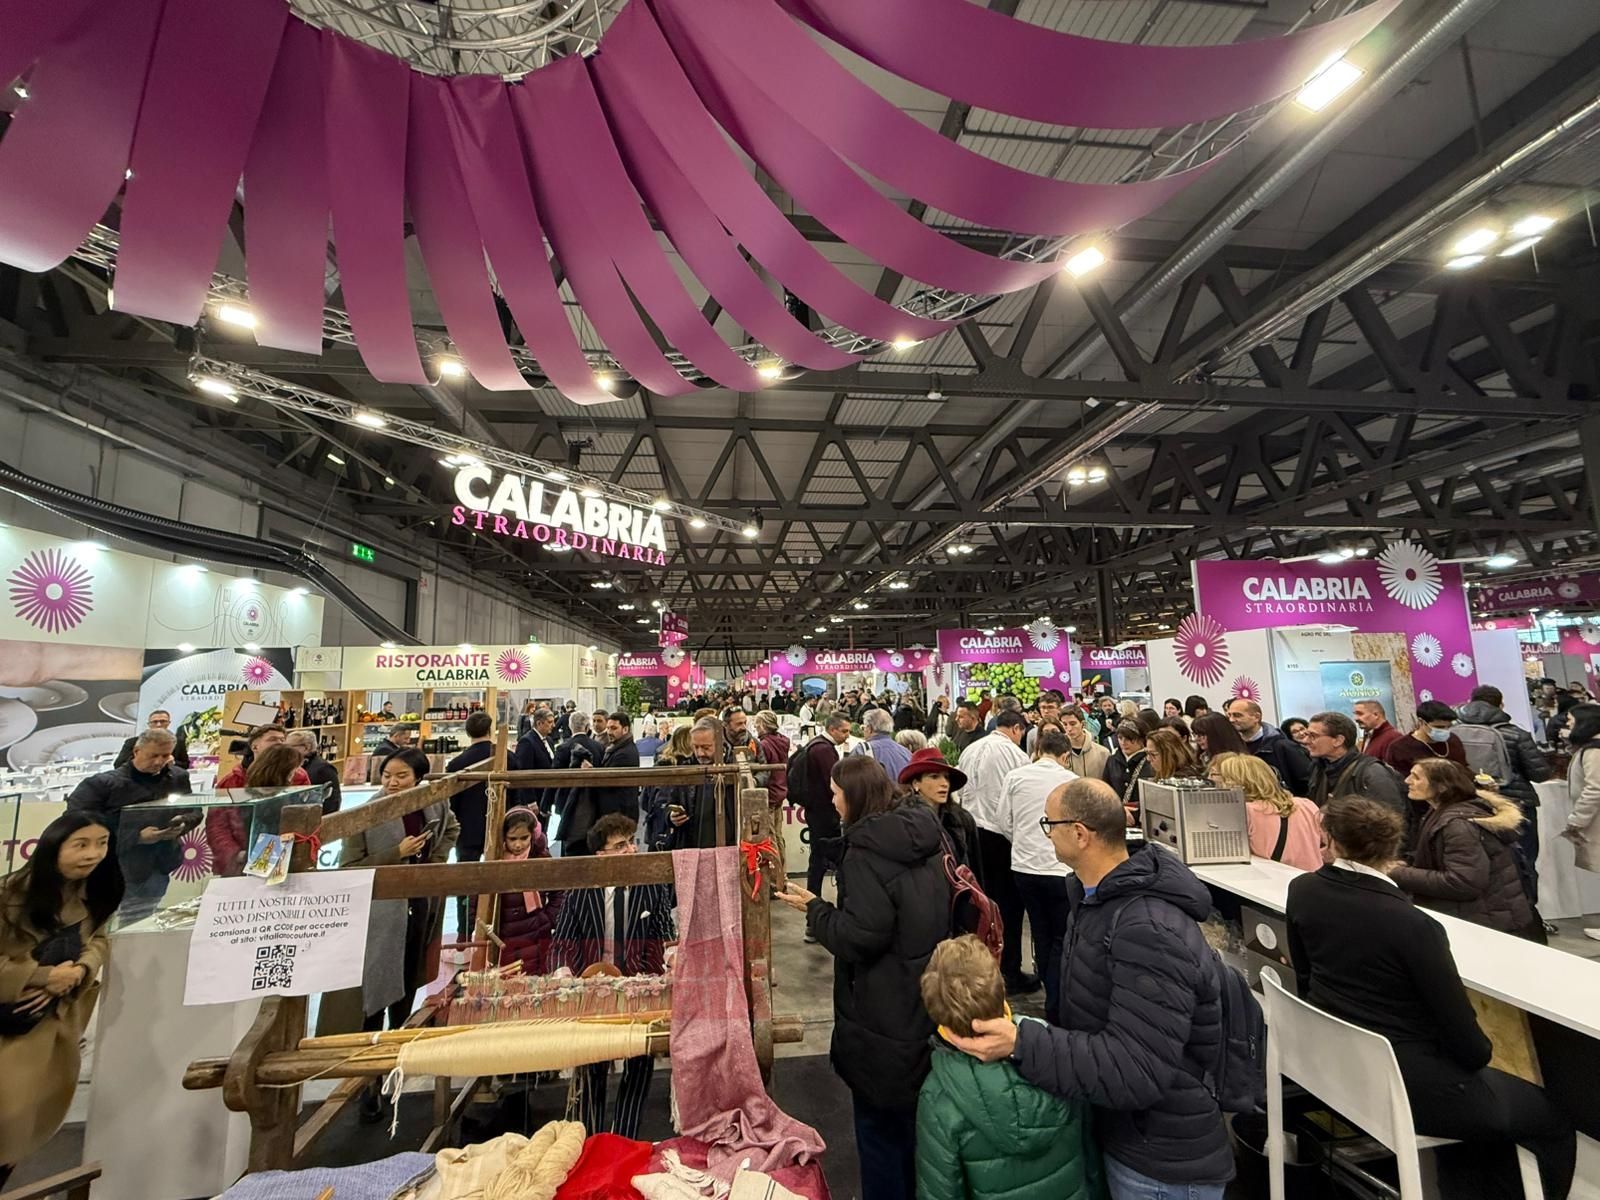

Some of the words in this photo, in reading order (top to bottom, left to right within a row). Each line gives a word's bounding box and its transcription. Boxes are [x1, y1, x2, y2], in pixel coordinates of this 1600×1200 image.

[453, 465, 667, 551] CALABRIA
[451, 506, 667, 567] STRAORDINARIA
[1242, 577, 1371, 601] CALABRIA
[1499, 587, 1553, 601] CALABRIA
[1245, 602, 1374, 613] STRAORDINARIA
[959, 636, 1022, 649] CALABRIA
[376, 653, 490, 668] RISTORANTE
[814, 653, 876, 664] CALABRIA
[1090, 649, 1145, 660] CALABRIA
[815, 663, 876, 671] STRAORDINARIA
[416, 669, 490, 681] CALABRIA
[216, 899, 247, 912] TUTTI
[258, 896, 297, 908] NOSTRI
[298, 893, 351, 905] PRODOTTI
[212, 914, 244, 926] SONO
[246, 909, 306, 923] DISPONIBILI
[308, 906, 350, 918] ONLINE
[209, 928, 250, 938] scansiona
[252, 926, 257, 934] il
[259, 925, 272, 933] QR
[294, 923, 308, 932] per
[309, 921, 349, 930] accedere
[240, 935, 257, 943] sito:
